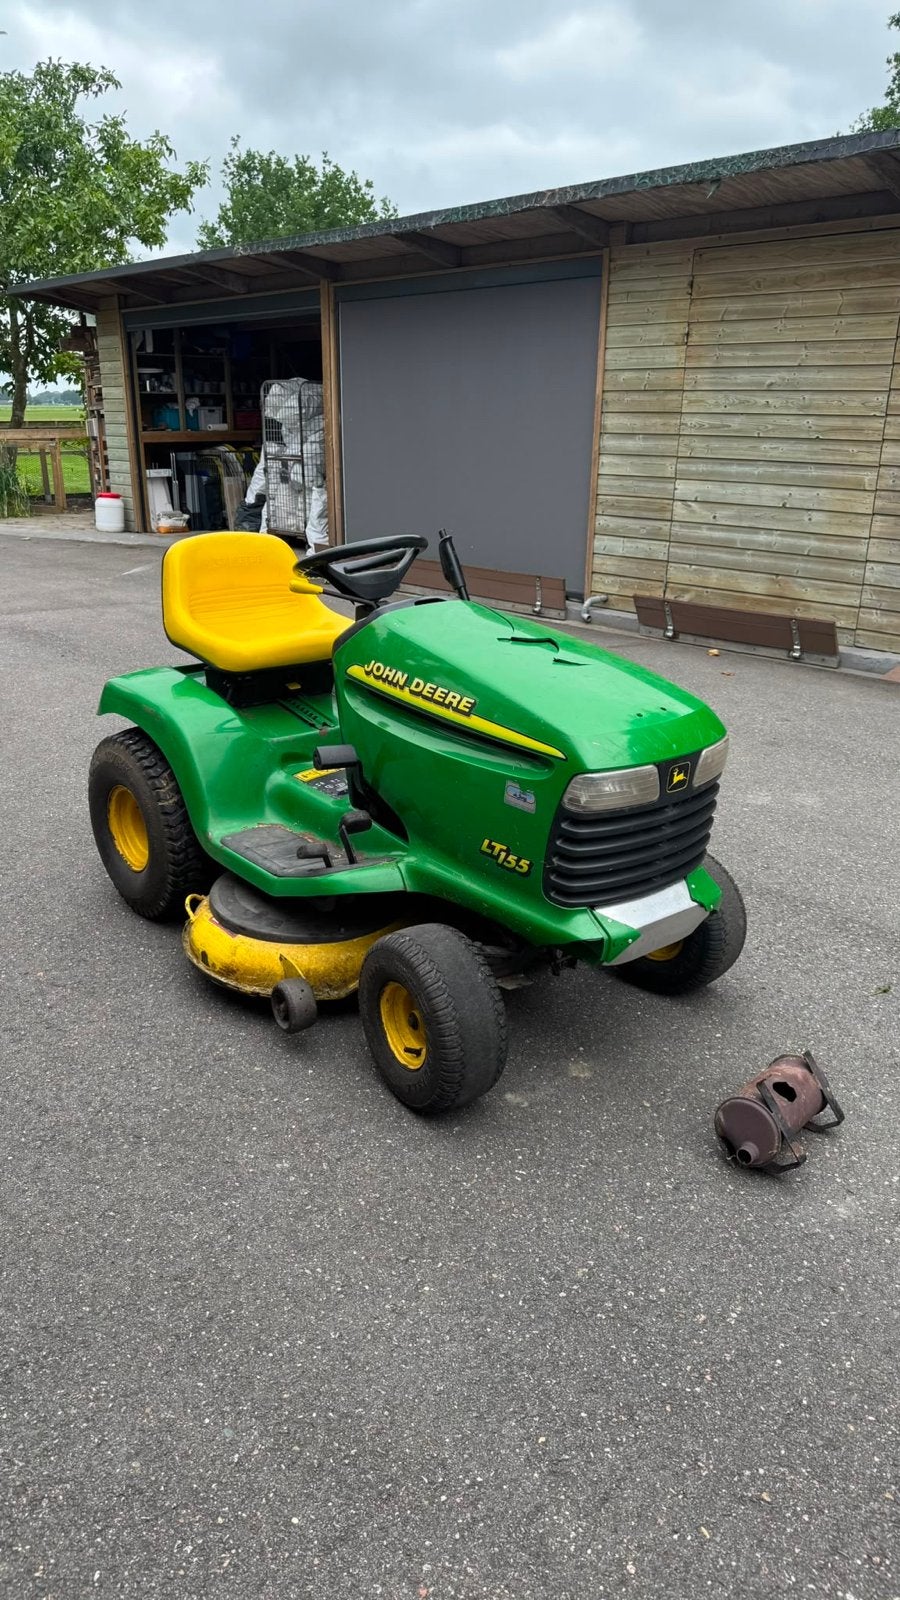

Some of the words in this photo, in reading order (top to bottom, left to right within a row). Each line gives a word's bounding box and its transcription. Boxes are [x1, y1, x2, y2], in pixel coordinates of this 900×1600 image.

[364, 659, 409, 688] JOHN
[409, 677, 476, 715] DEERE
[480, 838, 532, 875] LT155
